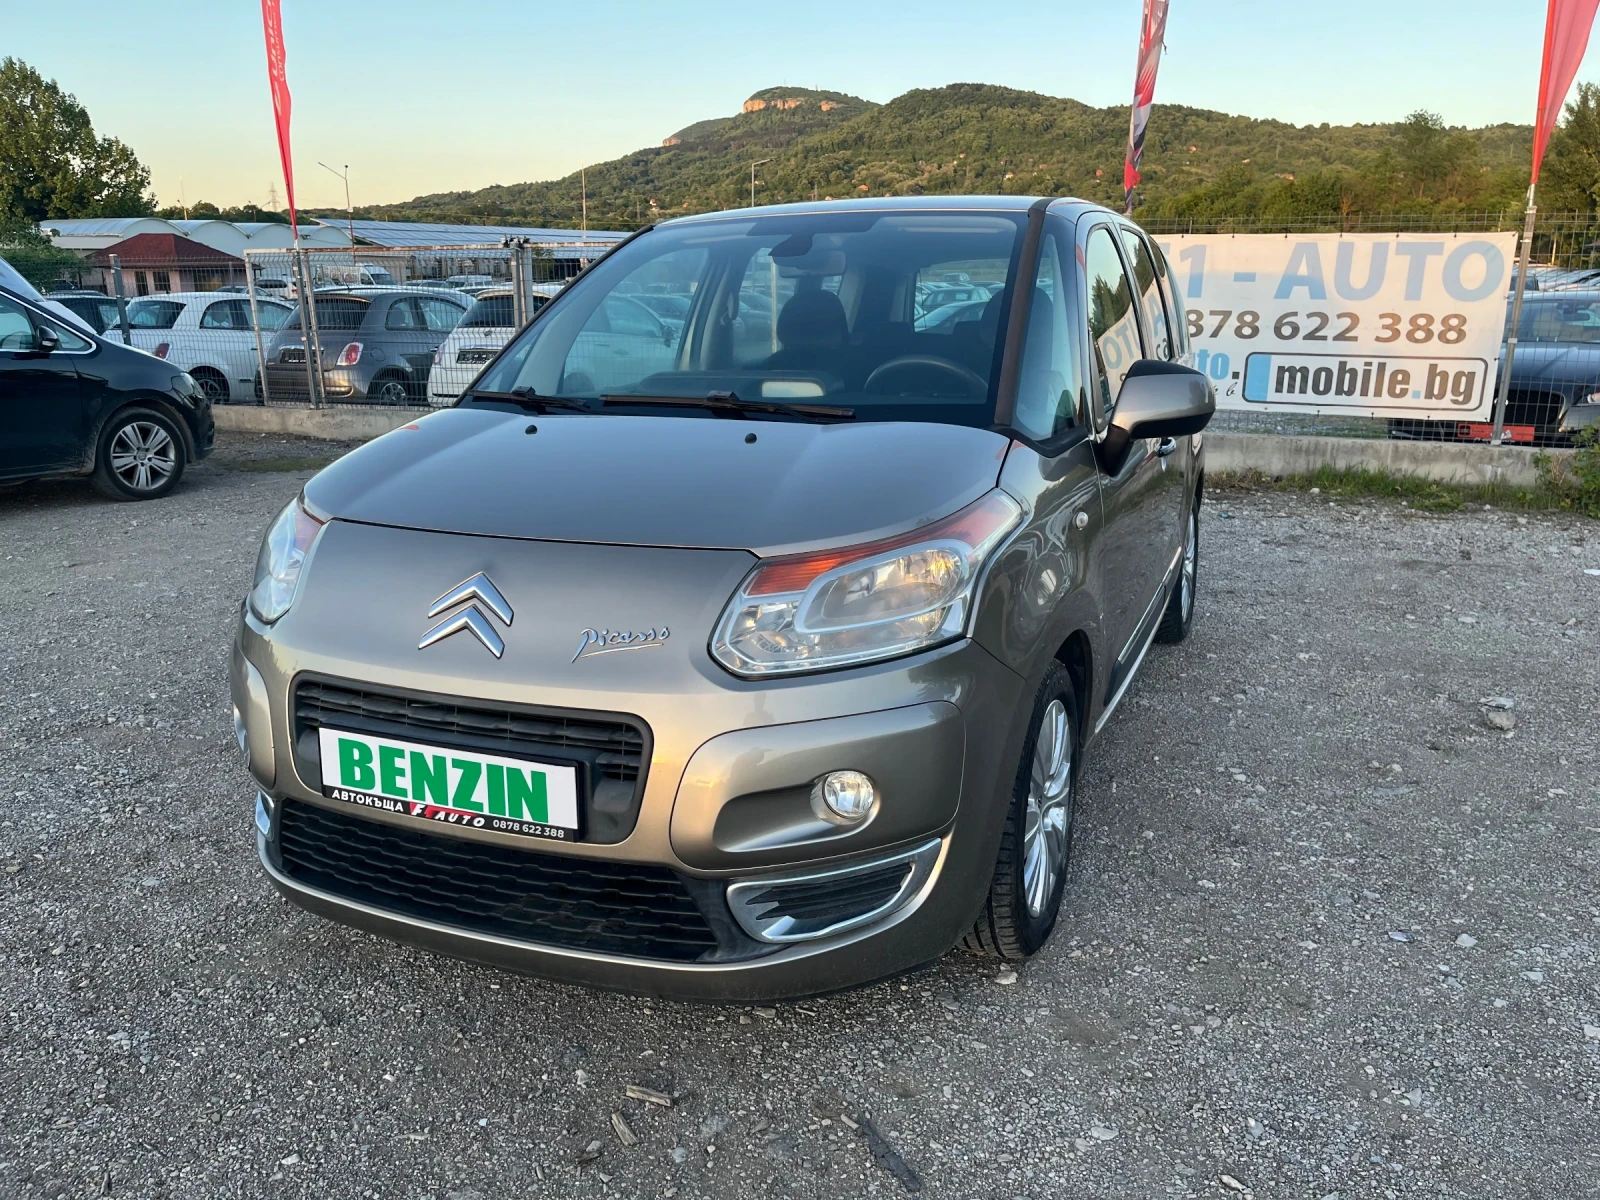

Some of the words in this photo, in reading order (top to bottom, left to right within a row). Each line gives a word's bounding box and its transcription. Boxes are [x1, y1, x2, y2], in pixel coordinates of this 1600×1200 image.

[1273, 240, 1506, 302] AUTO
[1273, 311, 1361, 343] 622
[1374, 312, 1468, 345] 388
[1274, 360, 1477, 405] mobile.bg
[571, 626, 671, 663] Picasso
[338, 738, 549, 824] BENZIN
[332, 789, 404, 812] АВТОКЪЩА
[492, 819, 520, 831] 0878
[522, 824, 542, 835] 622
[543, 827, 565, 838] 388
